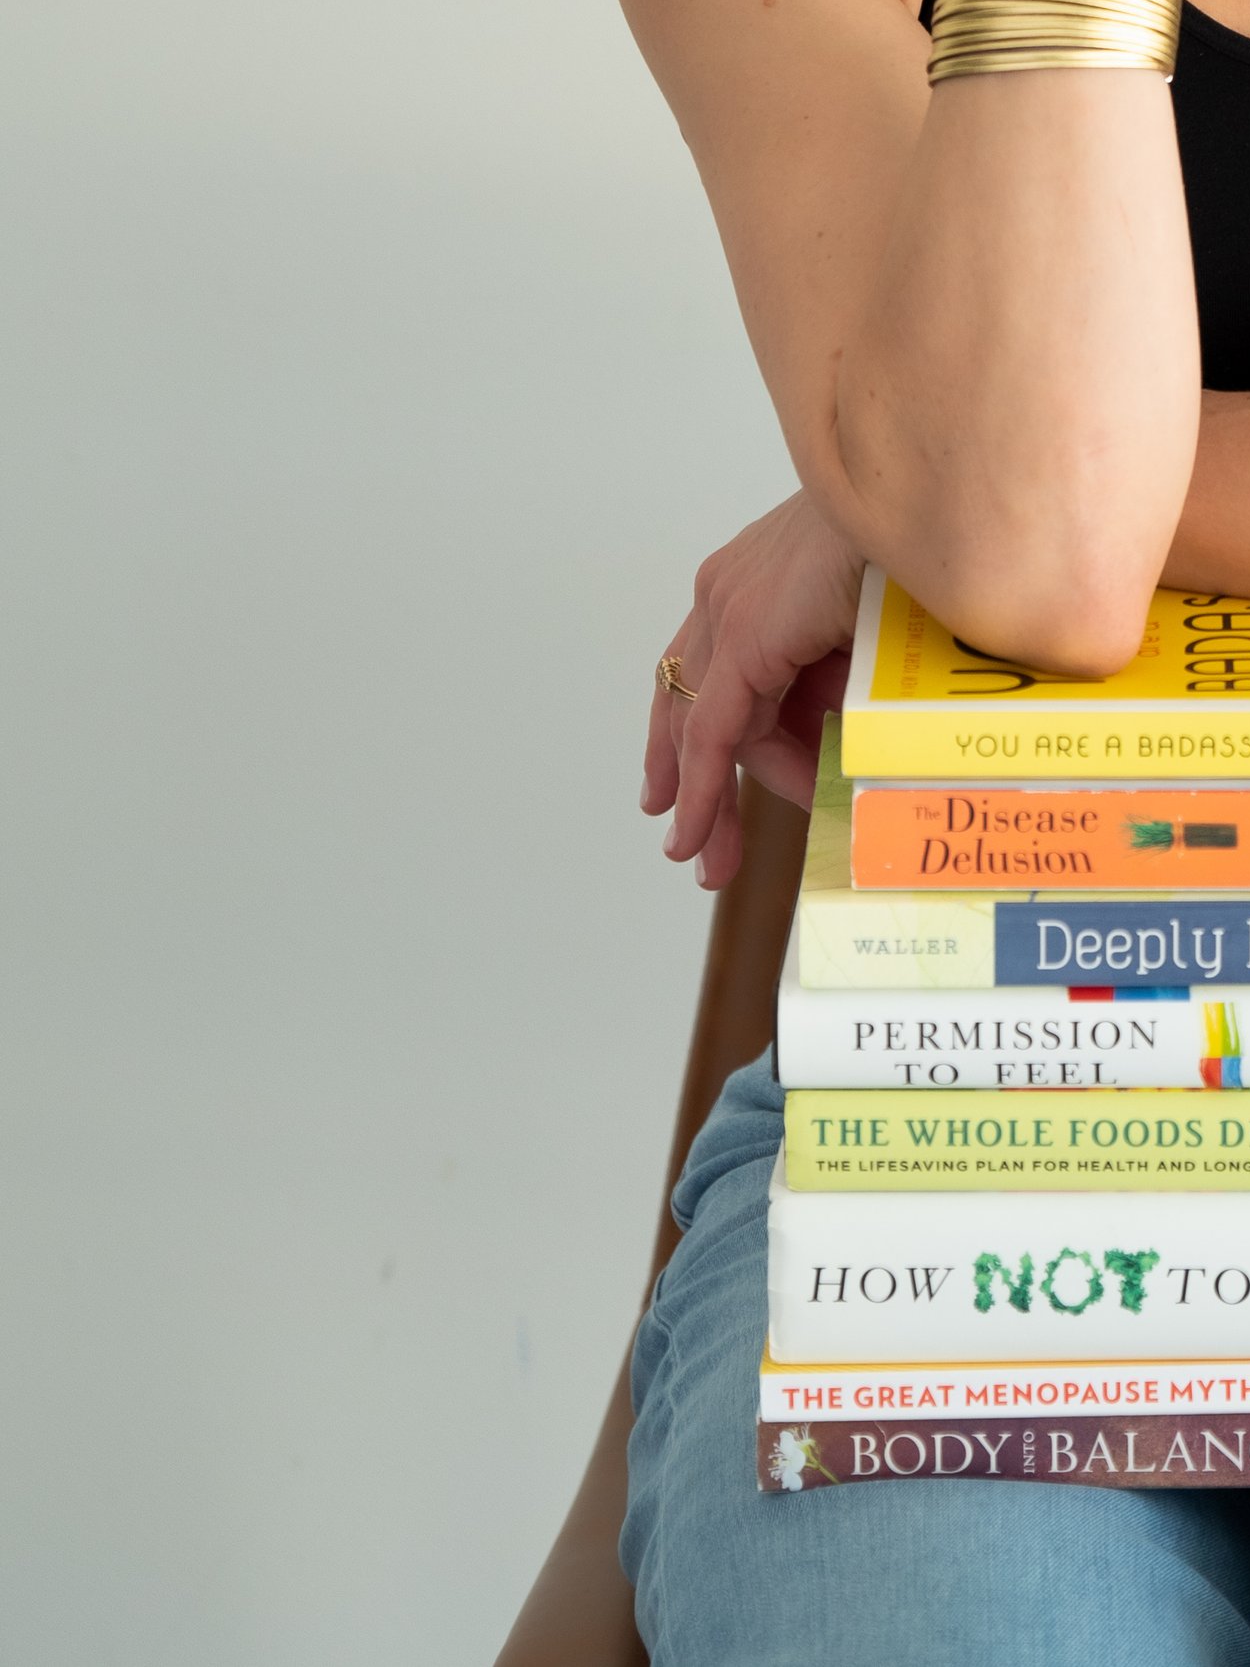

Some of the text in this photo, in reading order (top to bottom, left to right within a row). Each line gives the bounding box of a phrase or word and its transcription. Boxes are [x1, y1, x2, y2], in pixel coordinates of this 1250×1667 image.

[905, 622, 925, 649] TIMES
[903, 652, 921, 675] YORK
[955, 734, 1019, 758] YOU
[1034, 734, 1090, 758] ARE
[1105, 734, 1122, 758] A
[912, 797, 1100, 833] The Disease
[917, 838, 1096, 875] Delusion
[853, 938, 959, 955] WALLER
[1036, 918, 1225, 979] Deeply
[852, 1020, 1159, 1051] PERMISSION
[894, 1062, 1119, 1086] TO FEEL
[811, 1119, 890, 1147] THE
[905, 1118, 1054, 1148] WHOLE
[1068, 1118, 1205, 1148] FOODS
[816, 1160, 852, 1173] THE
[858, 1160, 969, 1173] LIFESAVING
[975, 1160, 1026, 1173] PLAN
[1032, 1160, 1071, 1173] FOR
[1077, 1160, 1150, 1173] HEALTH
[1156, 1160, 1197, 1173] AND
[808, 1265, 955, 1304] HOW
[971, 1245, 1161, 1316] NOT
[781, 1387, 843, 1410] THE
[853, 1384, 955, 1409] GREAT
[964, 1380, 1160, 1407] MENOPAUSE
[850, 1433, 1012, 1476] BODY
[1023, 1430, 1035, 1475] INTO
